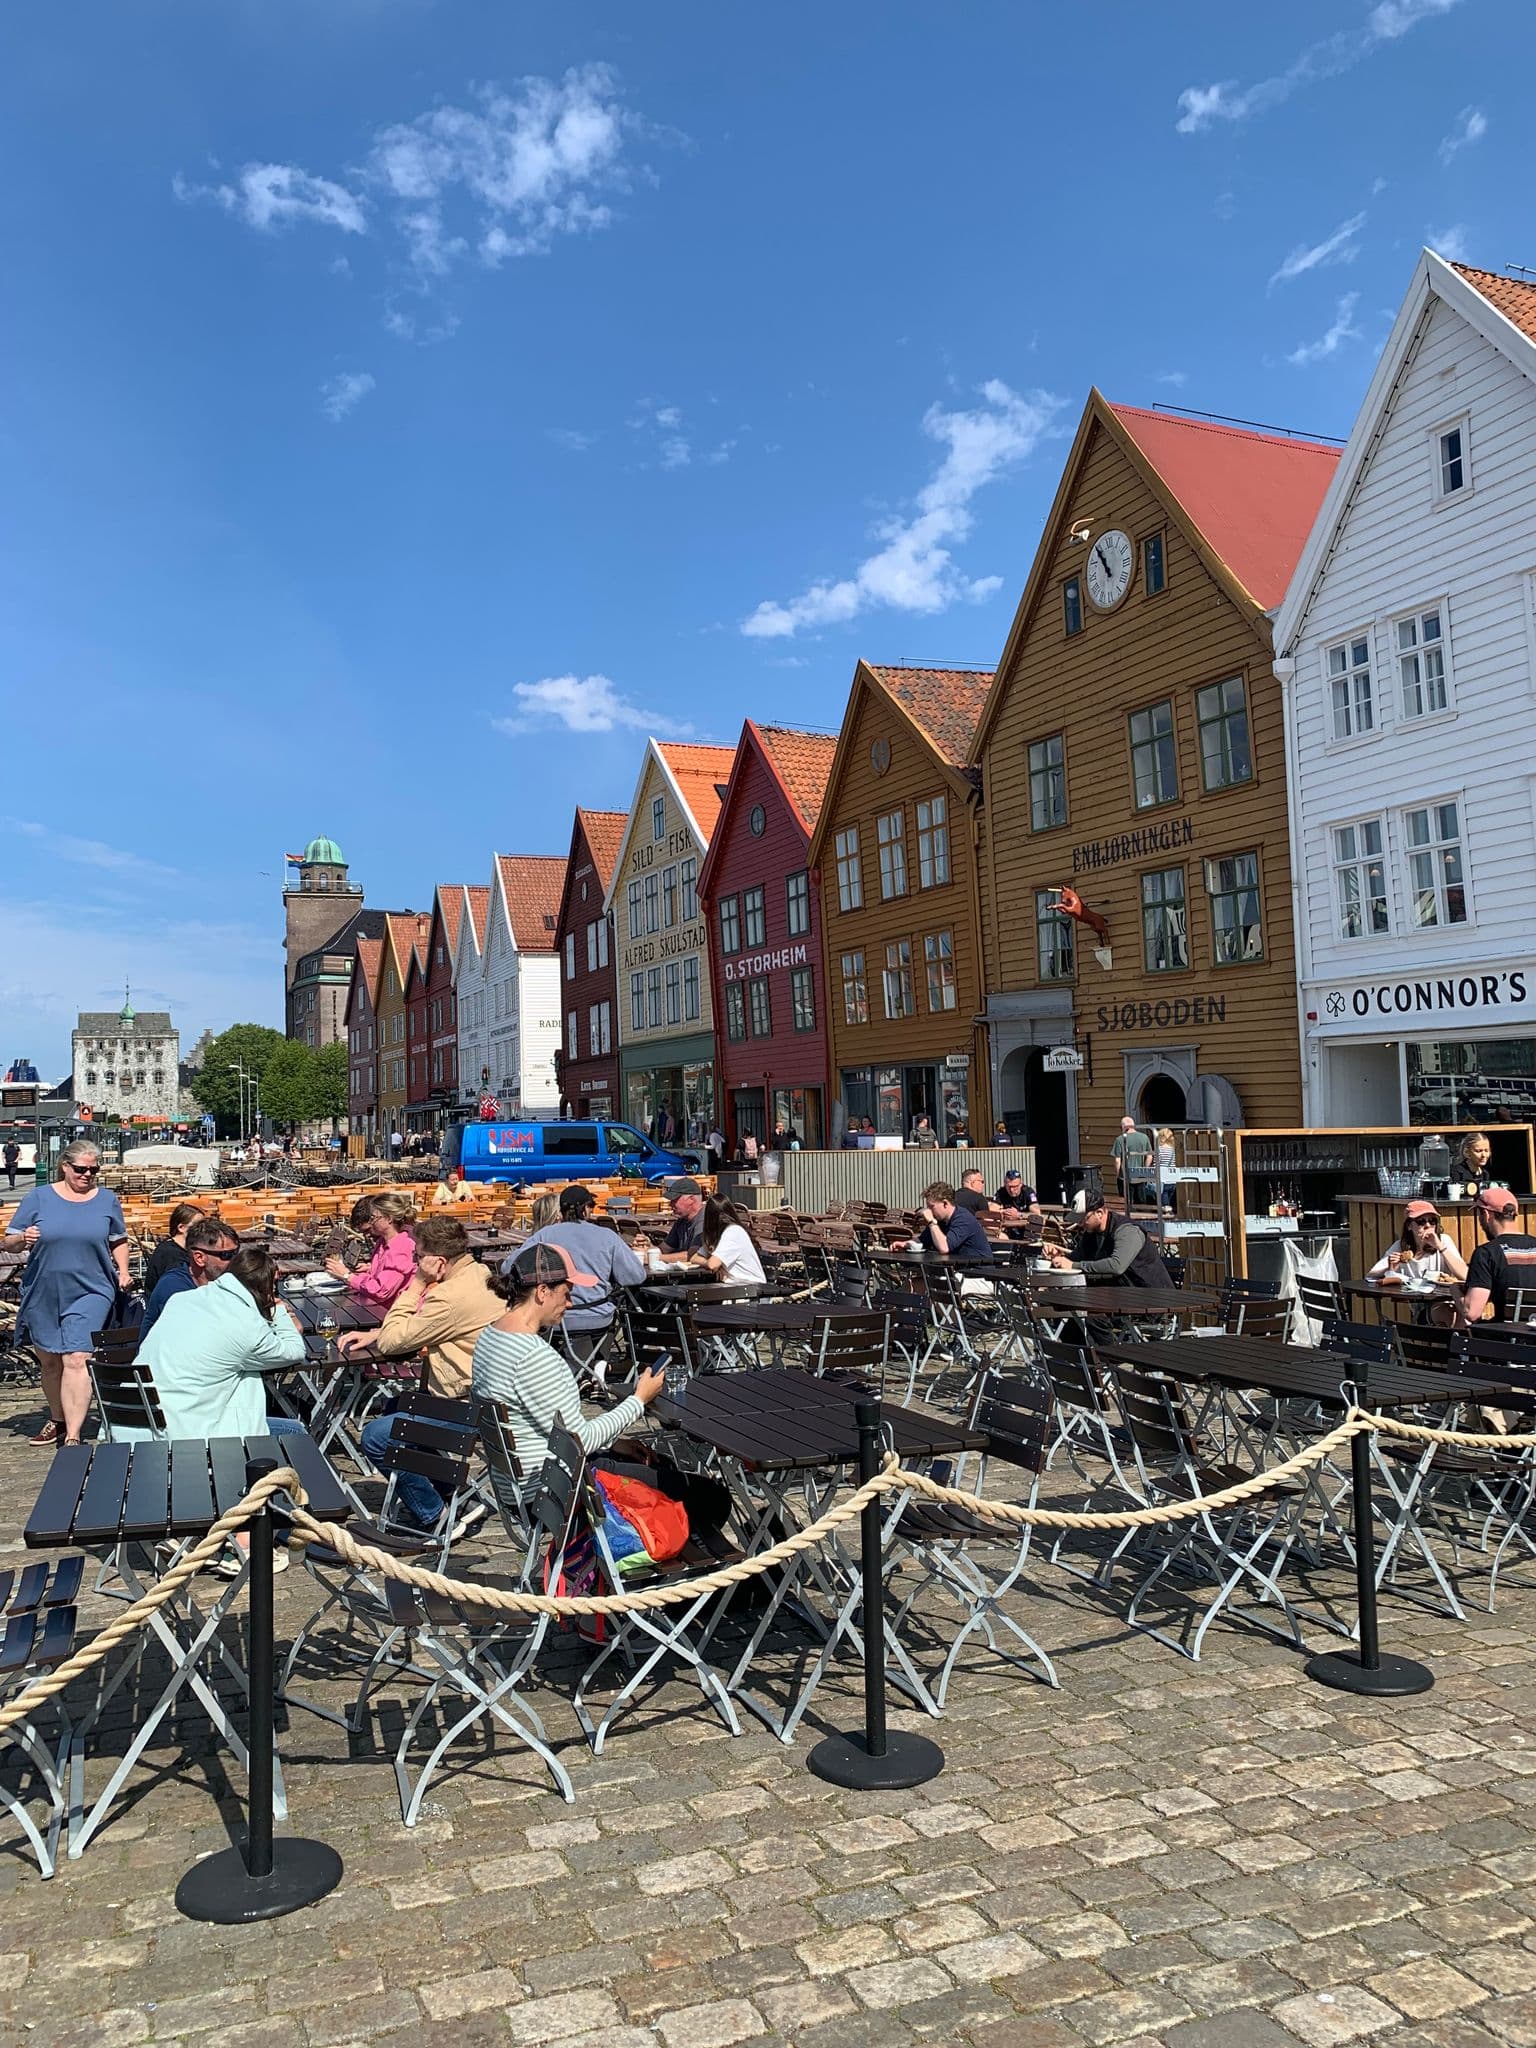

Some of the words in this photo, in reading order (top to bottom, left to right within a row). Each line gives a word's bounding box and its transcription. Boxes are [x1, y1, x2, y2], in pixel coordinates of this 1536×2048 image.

[1122, 557, 1131, 568] III
[632, 845, 654, 873] SILD
[669, 827, 692, 857] FISK
[1072, 817, 1194, 873] ENHJØRNINGEN
[624, 942, 655, 968] ALFRED
[660, 925, 706, 958] SKULSTAD
[739, 944, 807, 978] STORHEIM
[1097, 994, 1227, 1033] SJØBODEN
[1353, 972, 1527, 1016] O'CONNOR'S
